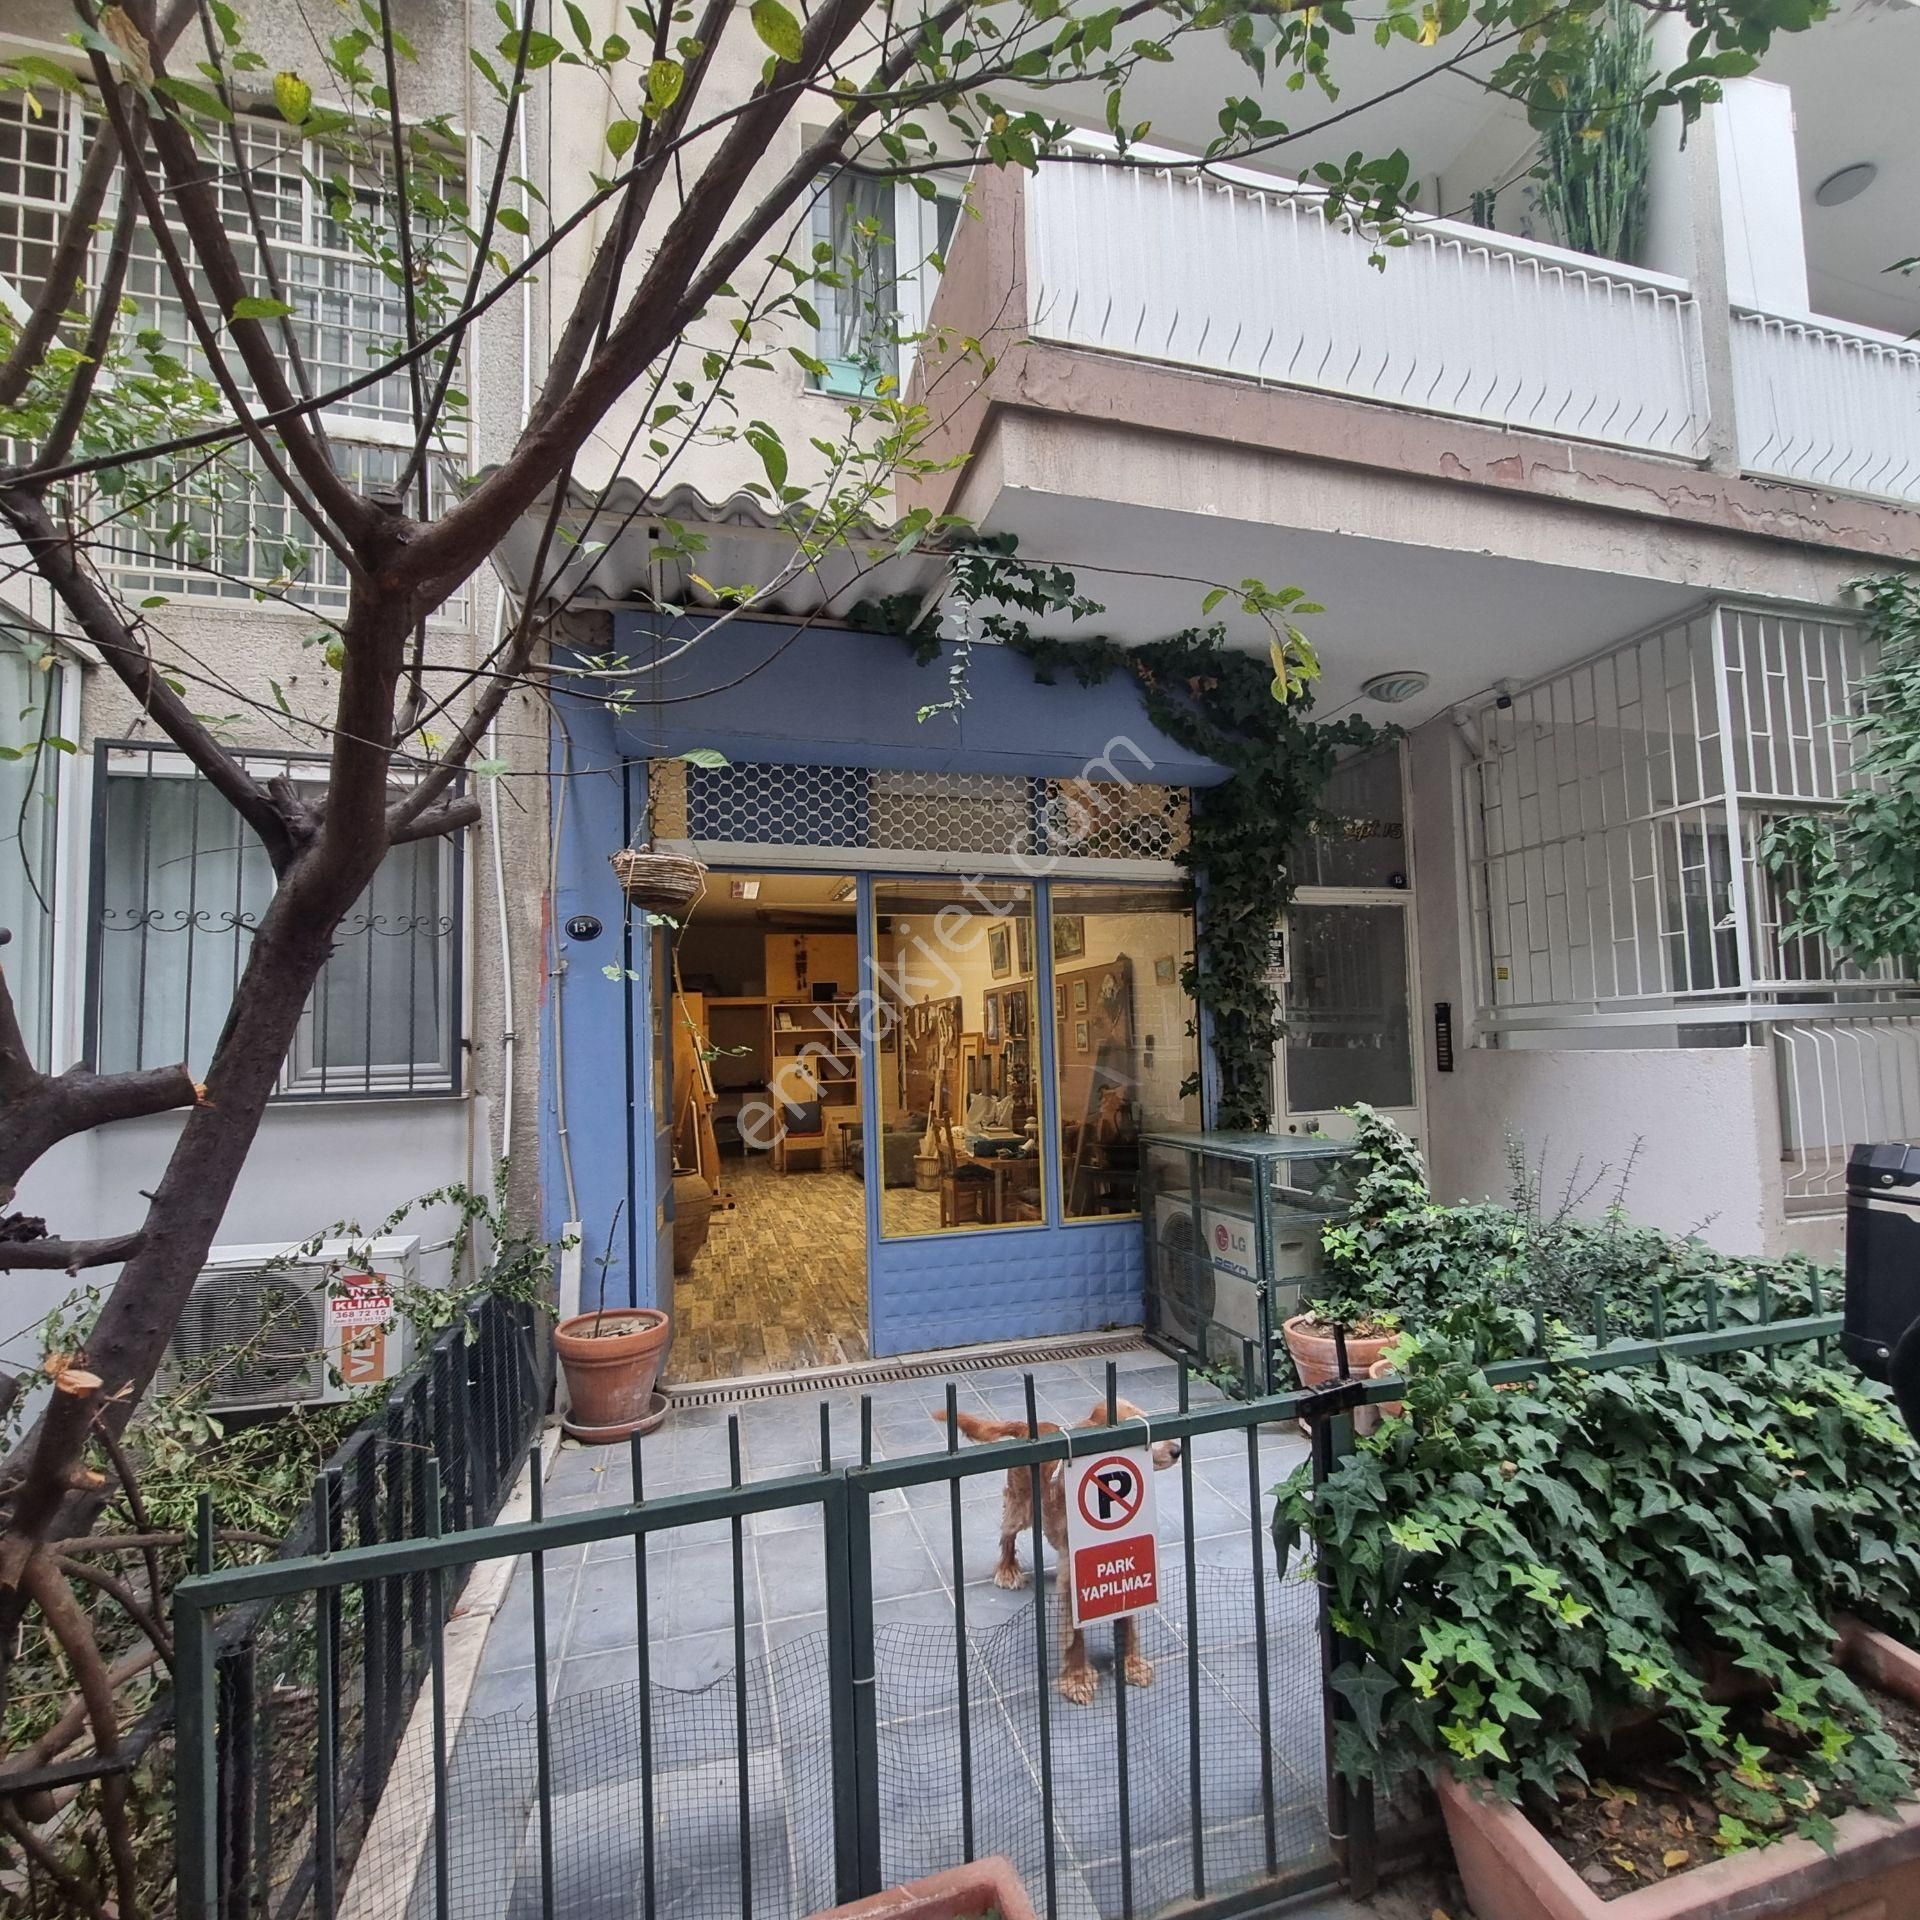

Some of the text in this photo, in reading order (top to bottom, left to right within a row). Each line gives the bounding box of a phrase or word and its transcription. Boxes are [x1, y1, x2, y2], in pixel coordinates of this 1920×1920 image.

[1231, 1234, 1247, 1252] LG
[336, 1311, 354, 1319] 368
[1096, 1556, 1136, 1578] PARK
[1081, 1573, 1153, 1602] YAPILMAZ
